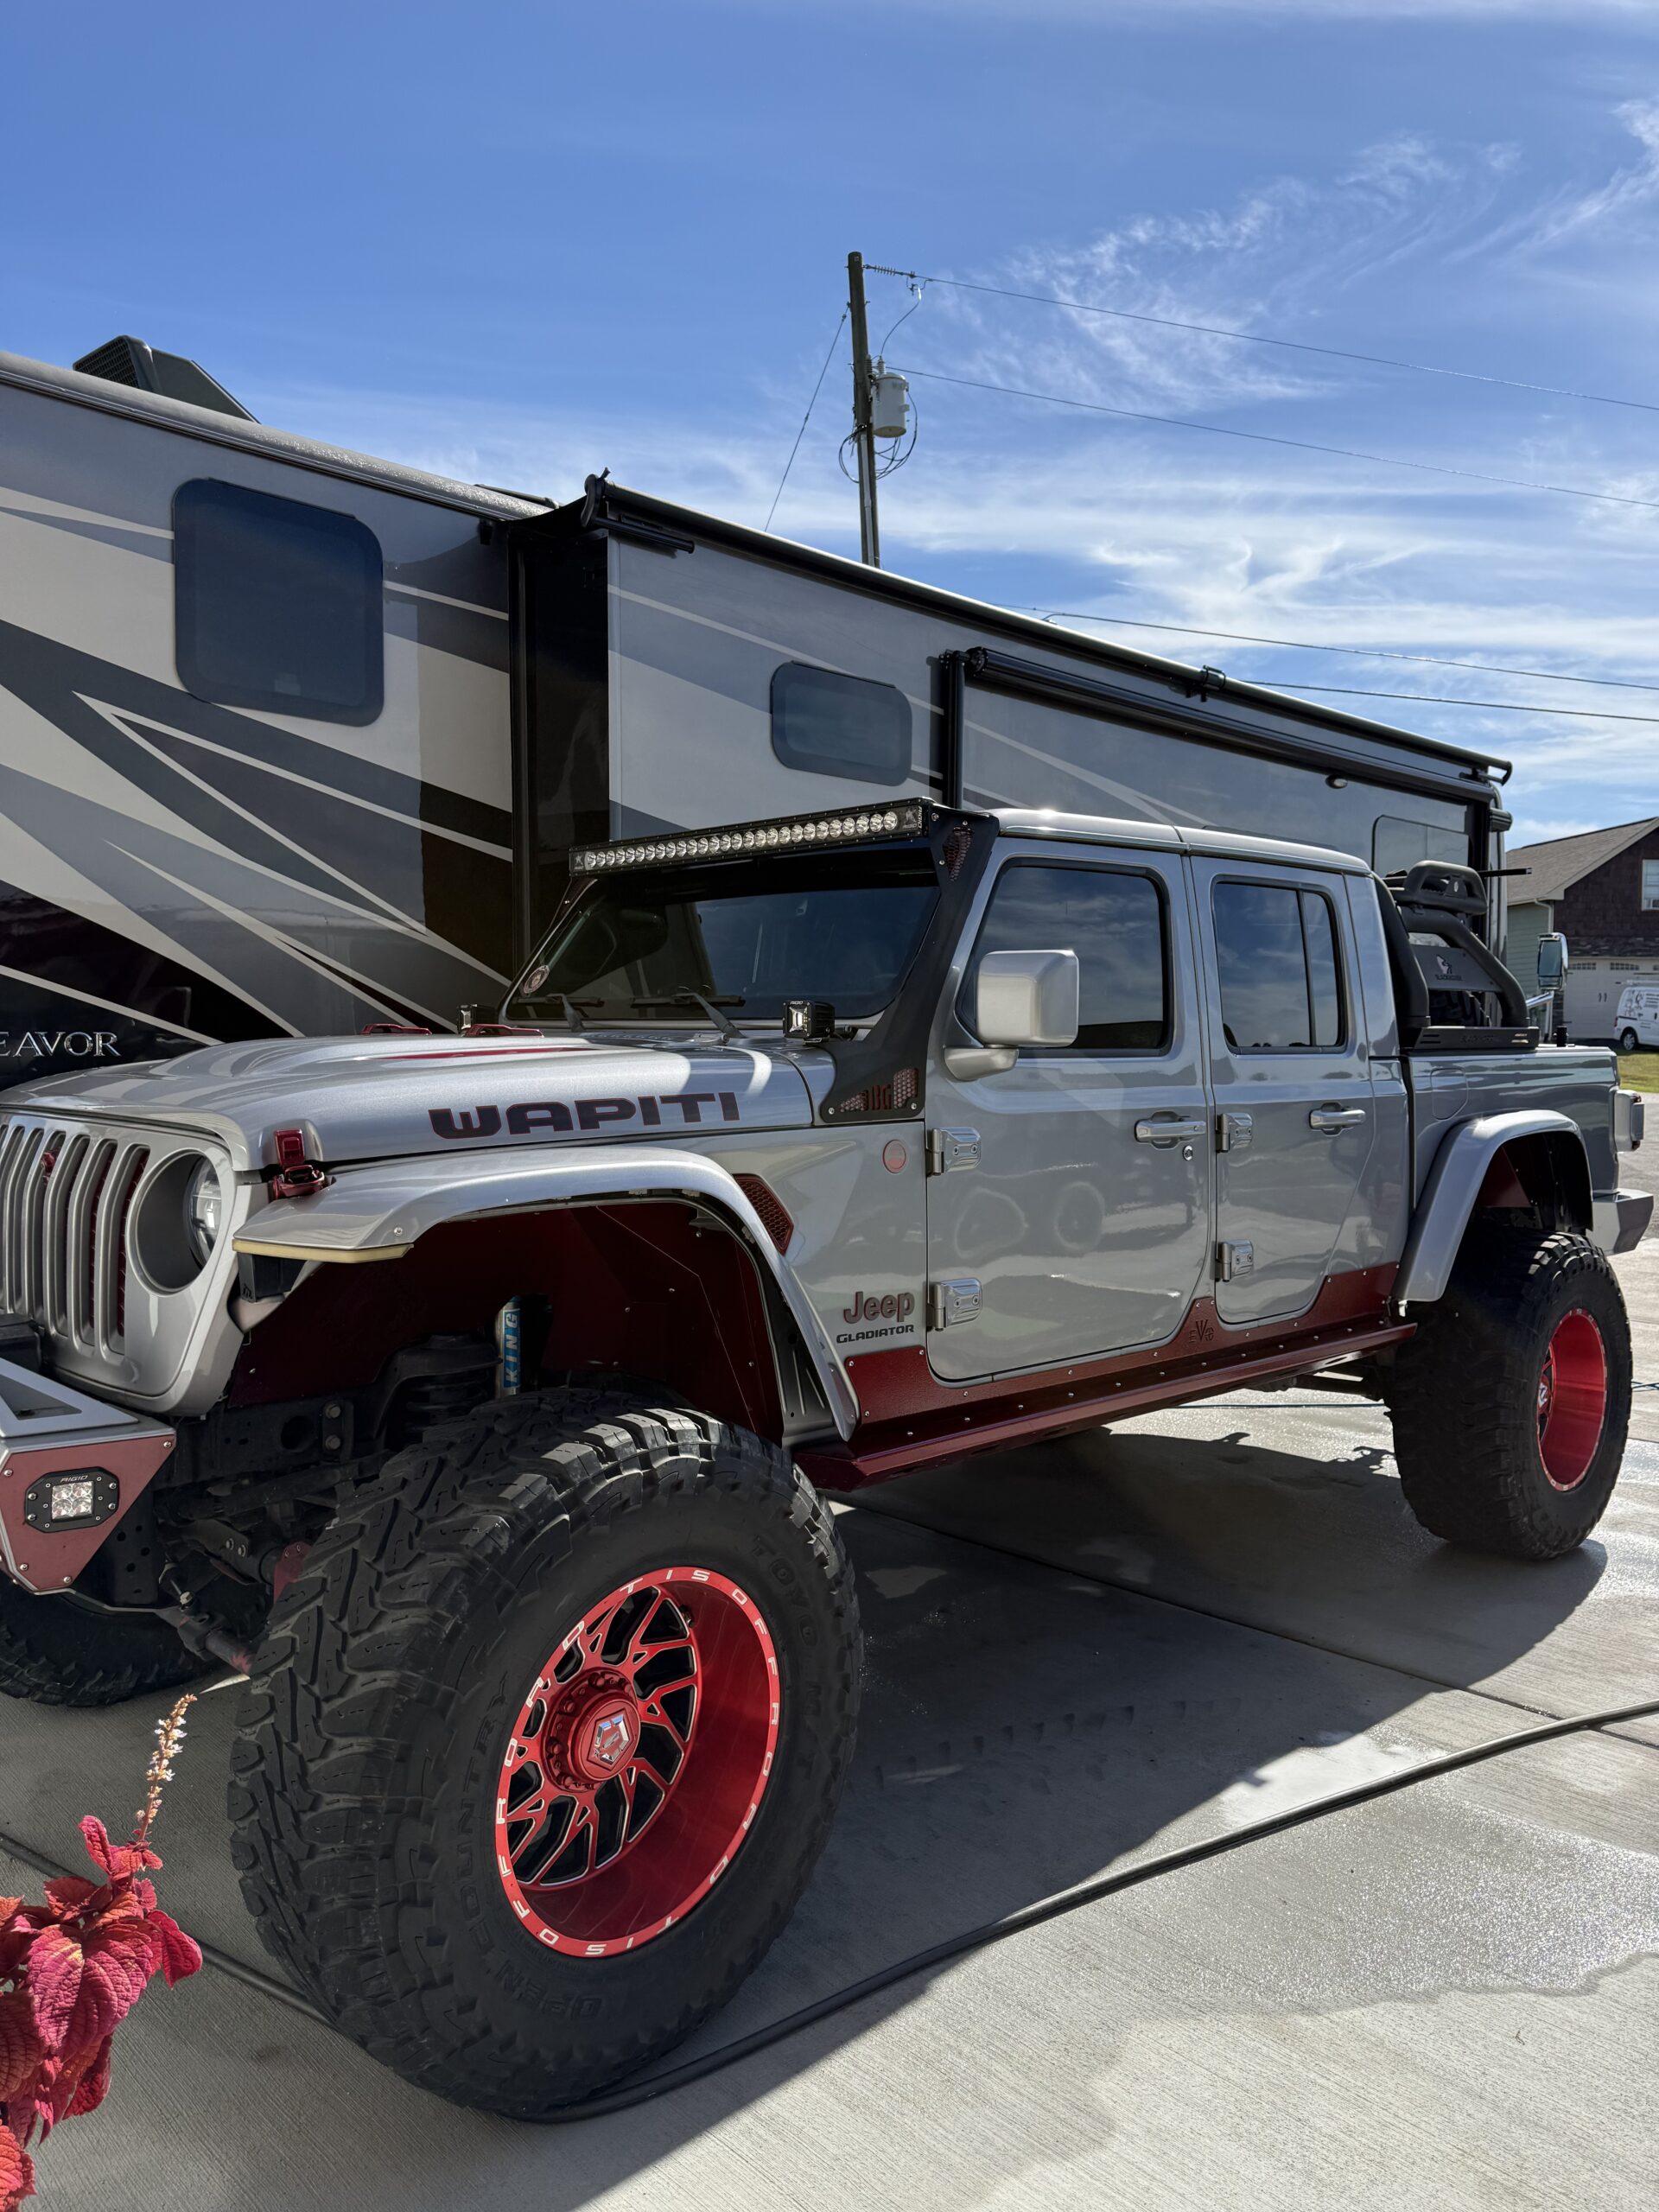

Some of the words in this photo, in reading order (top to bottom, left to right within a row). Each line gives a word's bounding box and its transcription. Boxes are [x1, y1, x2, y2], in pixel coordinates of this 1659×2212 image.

[428, 1091, 741, 1140] WAPITI
[842, 1291, 915, 1324] Jeep
[505, 1313, 518, 1383] KING
[836, 1324, 915, 1344] GLADIATOR
